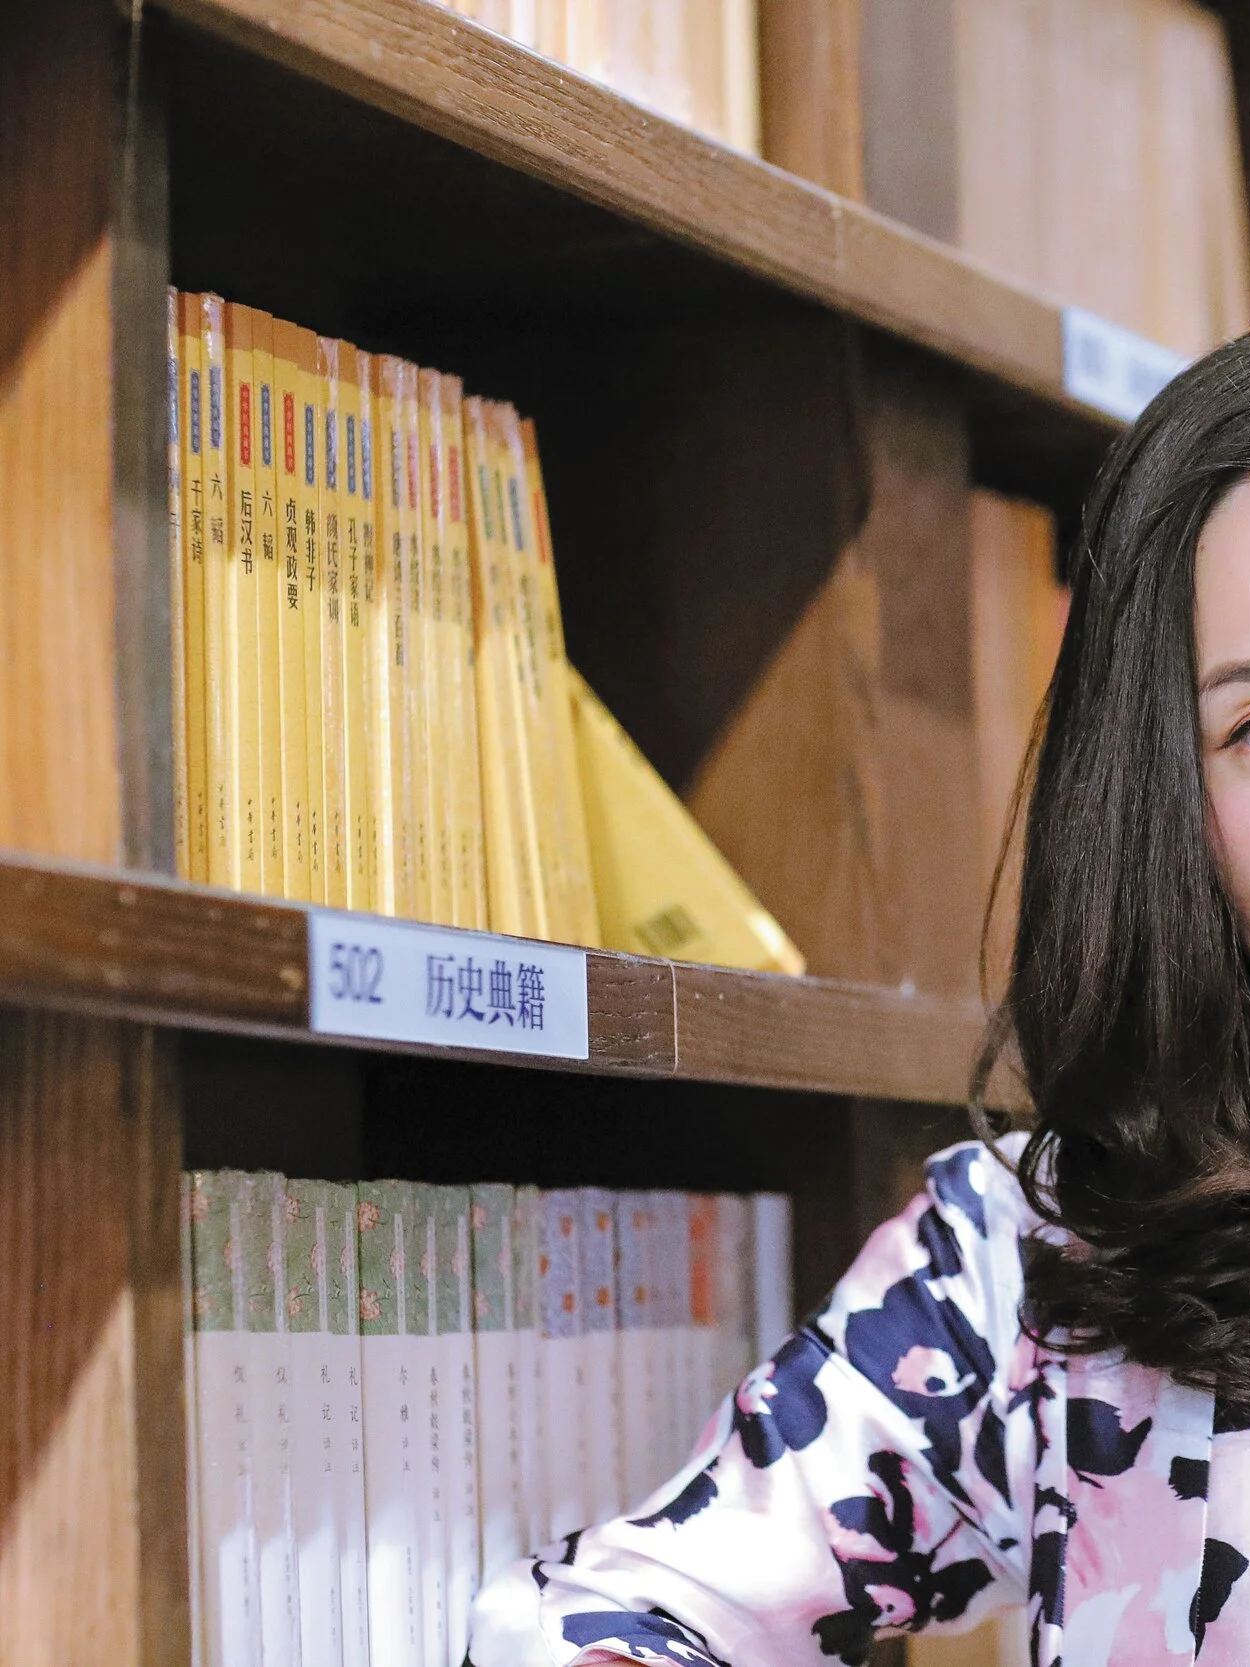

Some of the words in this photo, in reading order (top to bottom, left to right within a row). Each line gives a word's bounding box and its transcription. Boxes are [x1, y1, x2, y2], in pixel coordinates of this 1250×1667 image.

[241, 490, 253, 575] 后汉书
[262, 490, 274, 561] 六韬
[286, 498, 298, 610] 贞观政要
[305, 508, 316, 592] 韩非子
[326, 513, 339, 624] 颜氏家训
[348, 517, 359, 628] 孔子家语
[330, 942, 384, 1004] 502
[426, 953, 546, 1031] 历史典籍
